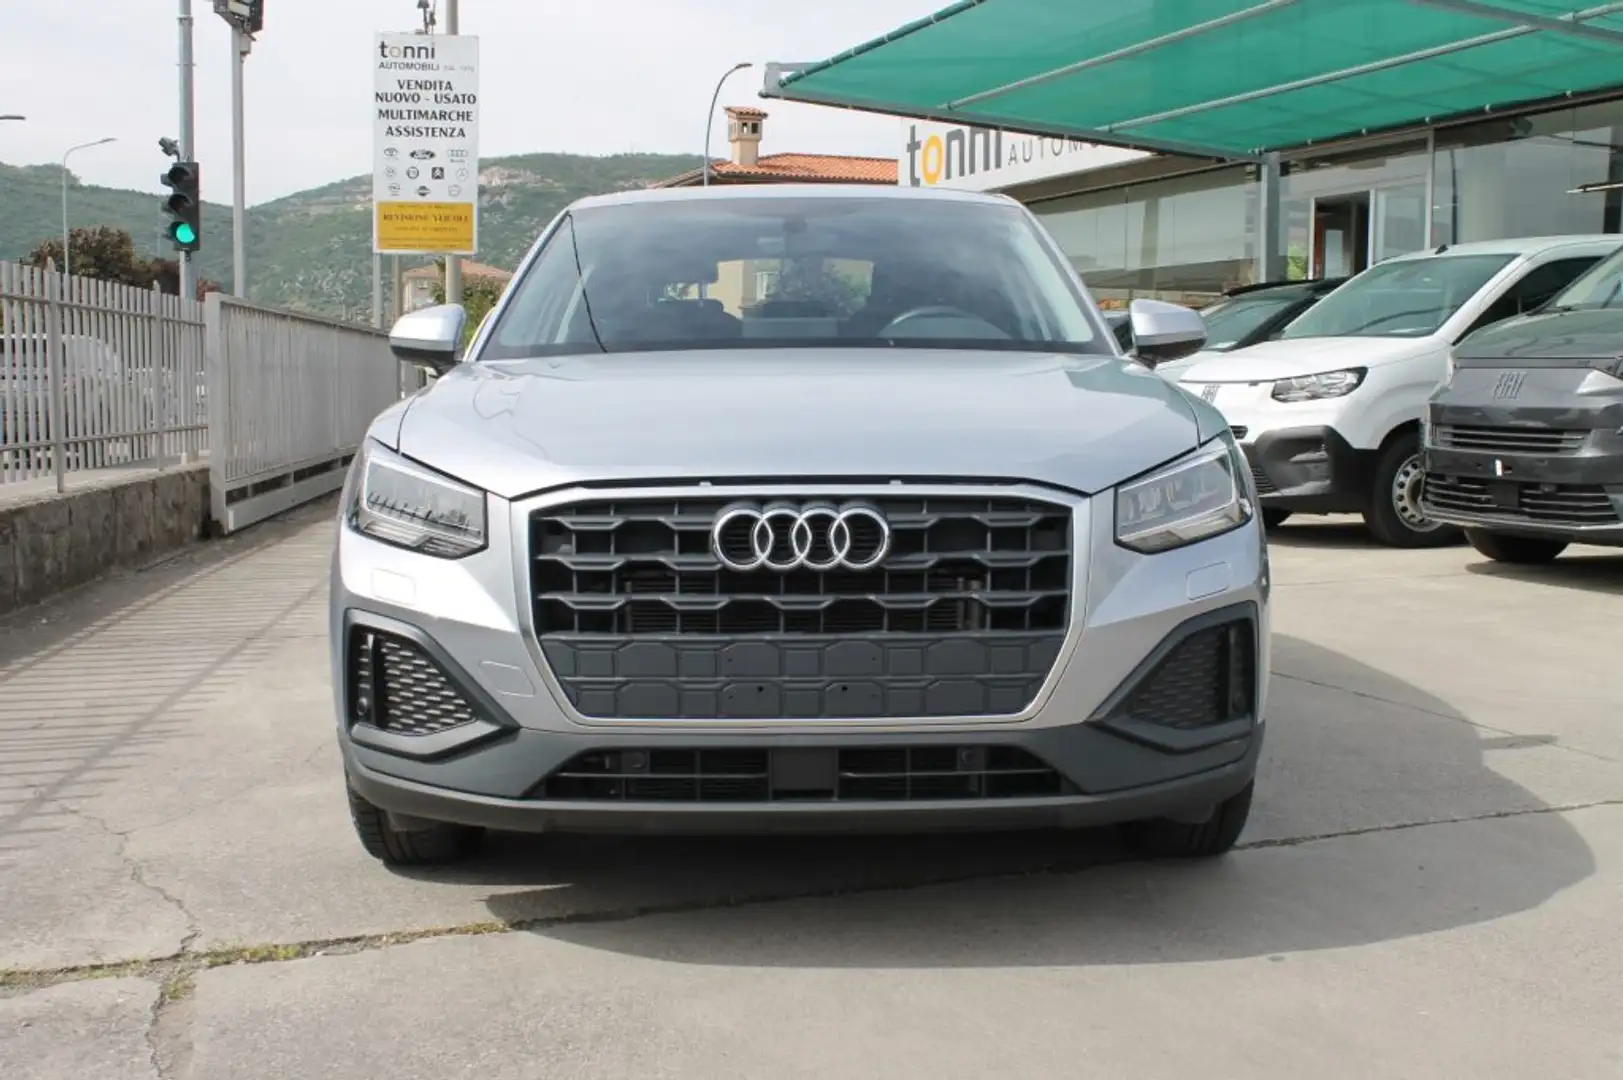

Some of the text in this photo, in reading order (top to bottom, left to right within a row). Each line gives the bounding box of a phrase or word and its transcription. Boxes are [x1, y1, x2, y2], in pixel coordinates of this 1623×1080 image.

[379, 41, 435, 59] tonni
[379, 61, 439, 71] AUTOMOBILI
[396, 79, 453, 91] VENDITA
[375, 92, 421, 103] NUOVO
[434, 93, 477, 105] USATO
[378, 109, 474, 122] MULTIMARCHE
[385, 125, 466, 138] ASSISTENZA
[906, 124, 1003, 188] tonni
